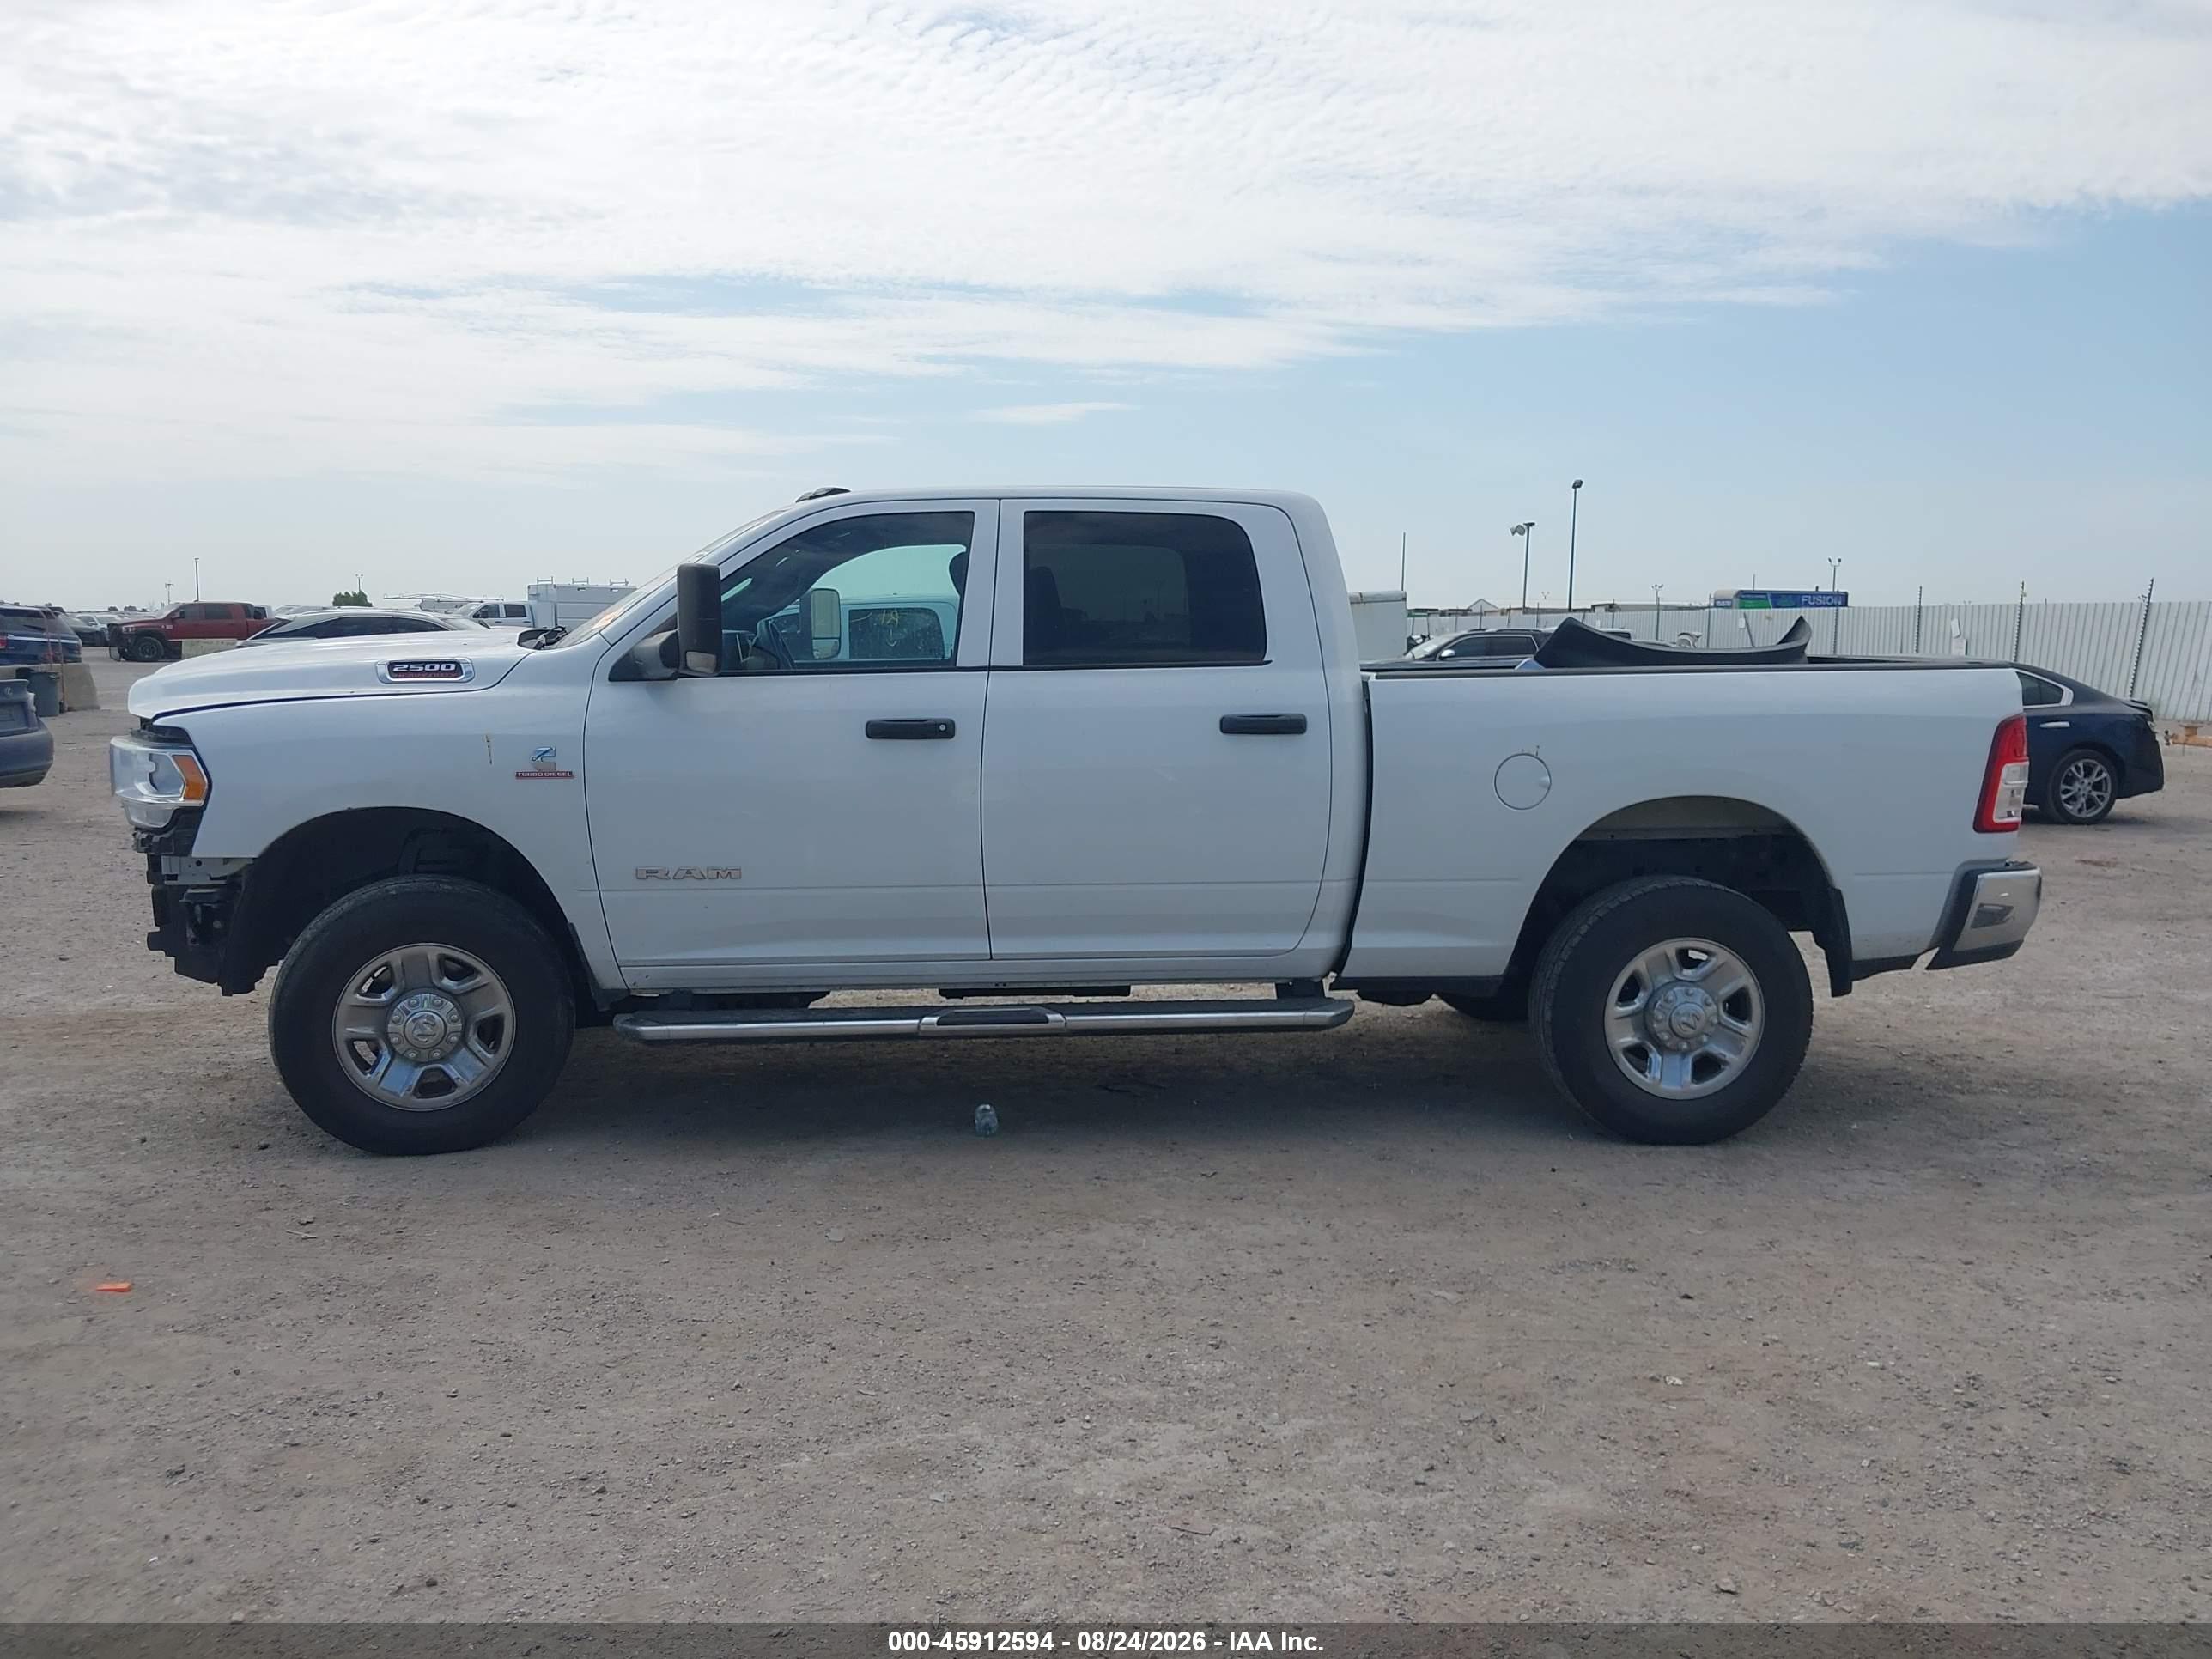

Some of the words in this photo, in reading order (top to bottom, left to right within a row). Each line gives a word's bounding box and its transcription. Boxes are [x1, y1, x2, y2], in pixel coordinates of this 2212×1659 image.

[1801, 594, 1842, 606] FUSION
[392, 663, 456, 672] 2500
[635, 866, 742, 880] RAM
